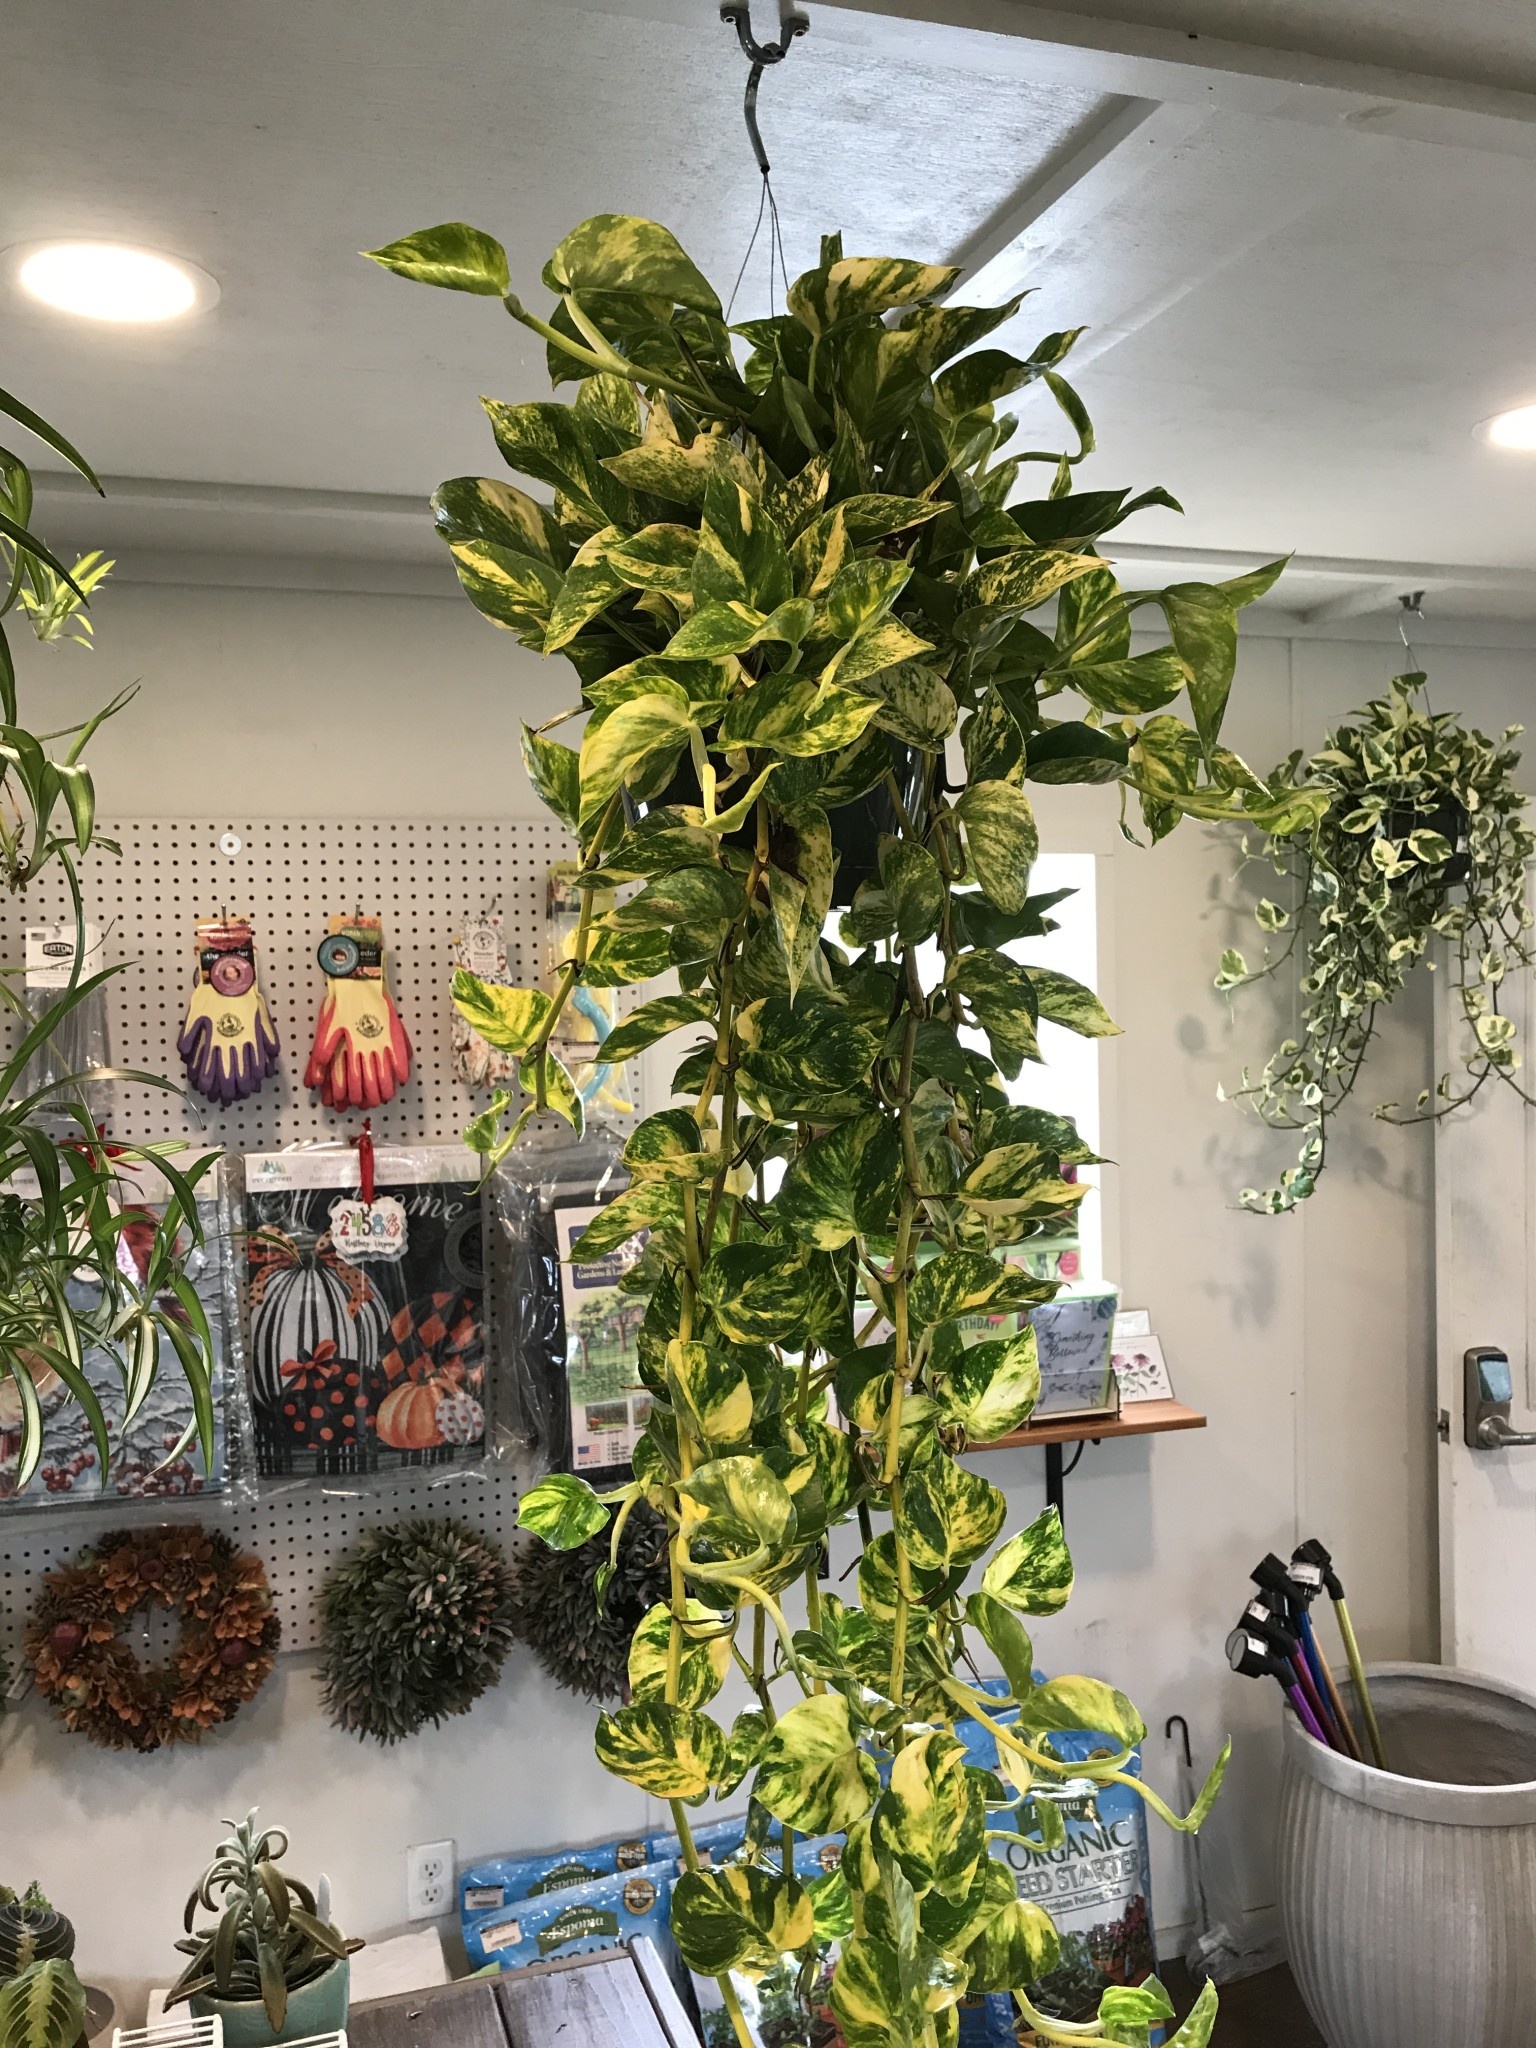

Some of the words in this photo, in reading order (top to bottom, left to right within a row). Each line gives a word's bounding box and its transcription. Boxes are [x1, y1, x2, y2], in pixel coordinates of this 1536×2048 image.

[44, 945, 73, 953] EATON
[1006, 1820, 1134, 1871] ORGANIC
[1054, 1849, 1139, 1892] STARTER
[1016, 1870, 1054, 1899] EED
[1045, 1899, 1074, 1910] remium
[1073, 1892, 1104, 1905] Potting
[551, 1916, 604, 1940] Espoma
